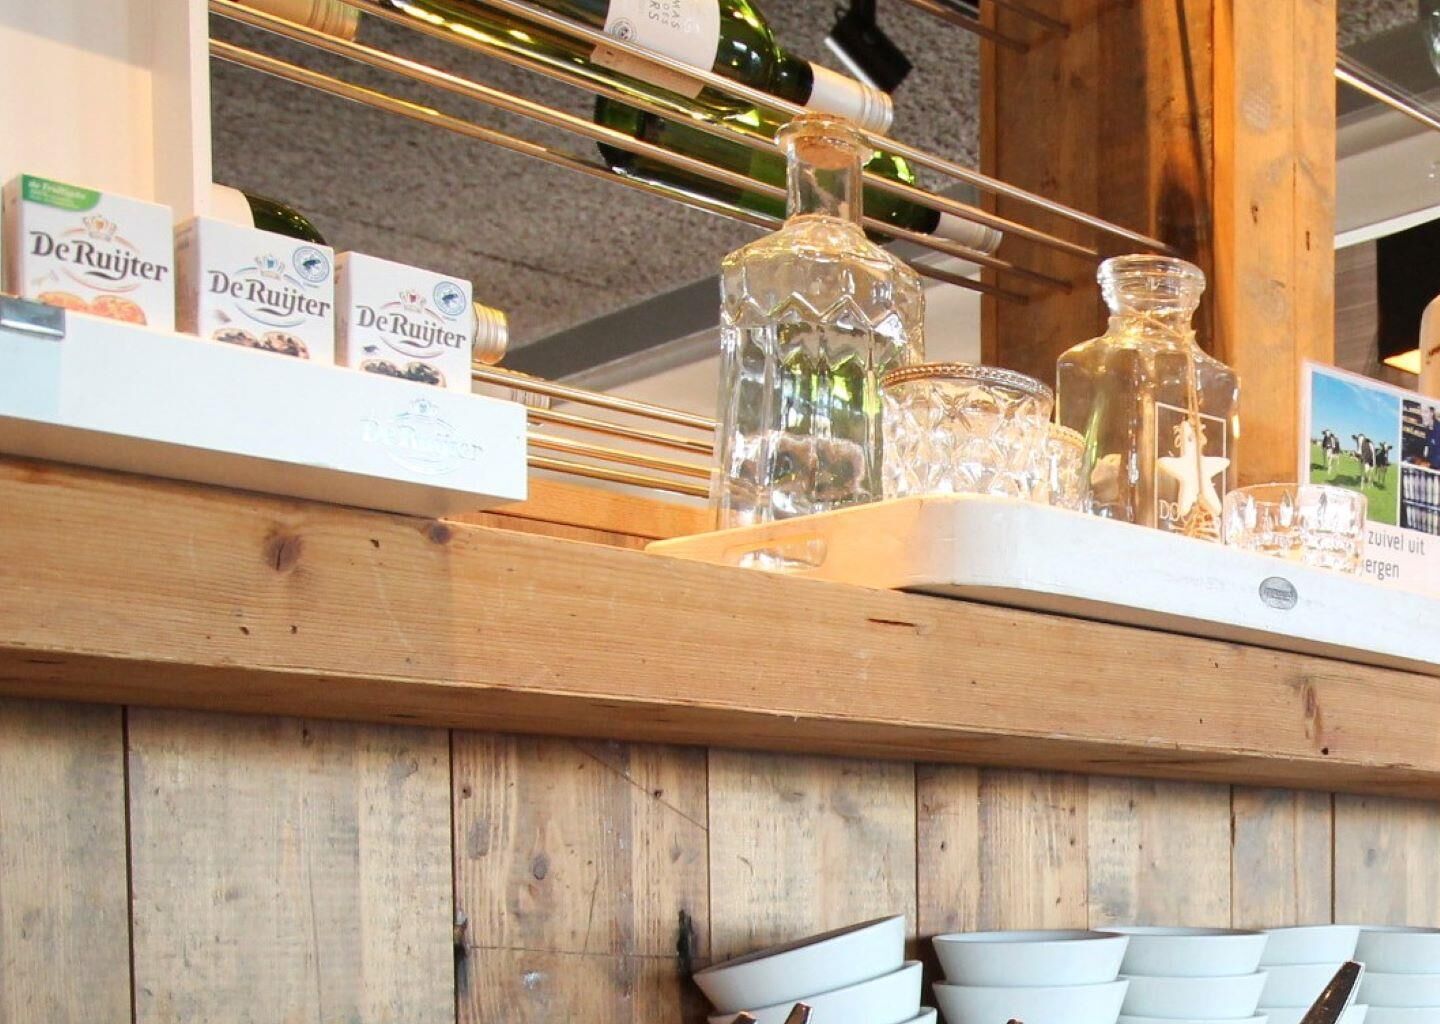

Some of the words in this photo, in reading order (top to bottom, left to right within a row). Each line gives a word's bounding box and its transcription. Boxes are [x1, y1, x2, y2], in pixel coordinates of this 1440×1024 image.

[29, 231, 69, 261] De
[71, 240, 168, 282] Ruijter
[207, 270, 243, 298] De
[245, 279, 330, 318] Ruijter
[355, 305, 388, 331] De
[389, 313, 466, 348] Ruijter
[1368, 529, 1403, 552] zuivel
[1408, 536, 1425, 555] uit
[1363, 556, 1400, 580] ergen
